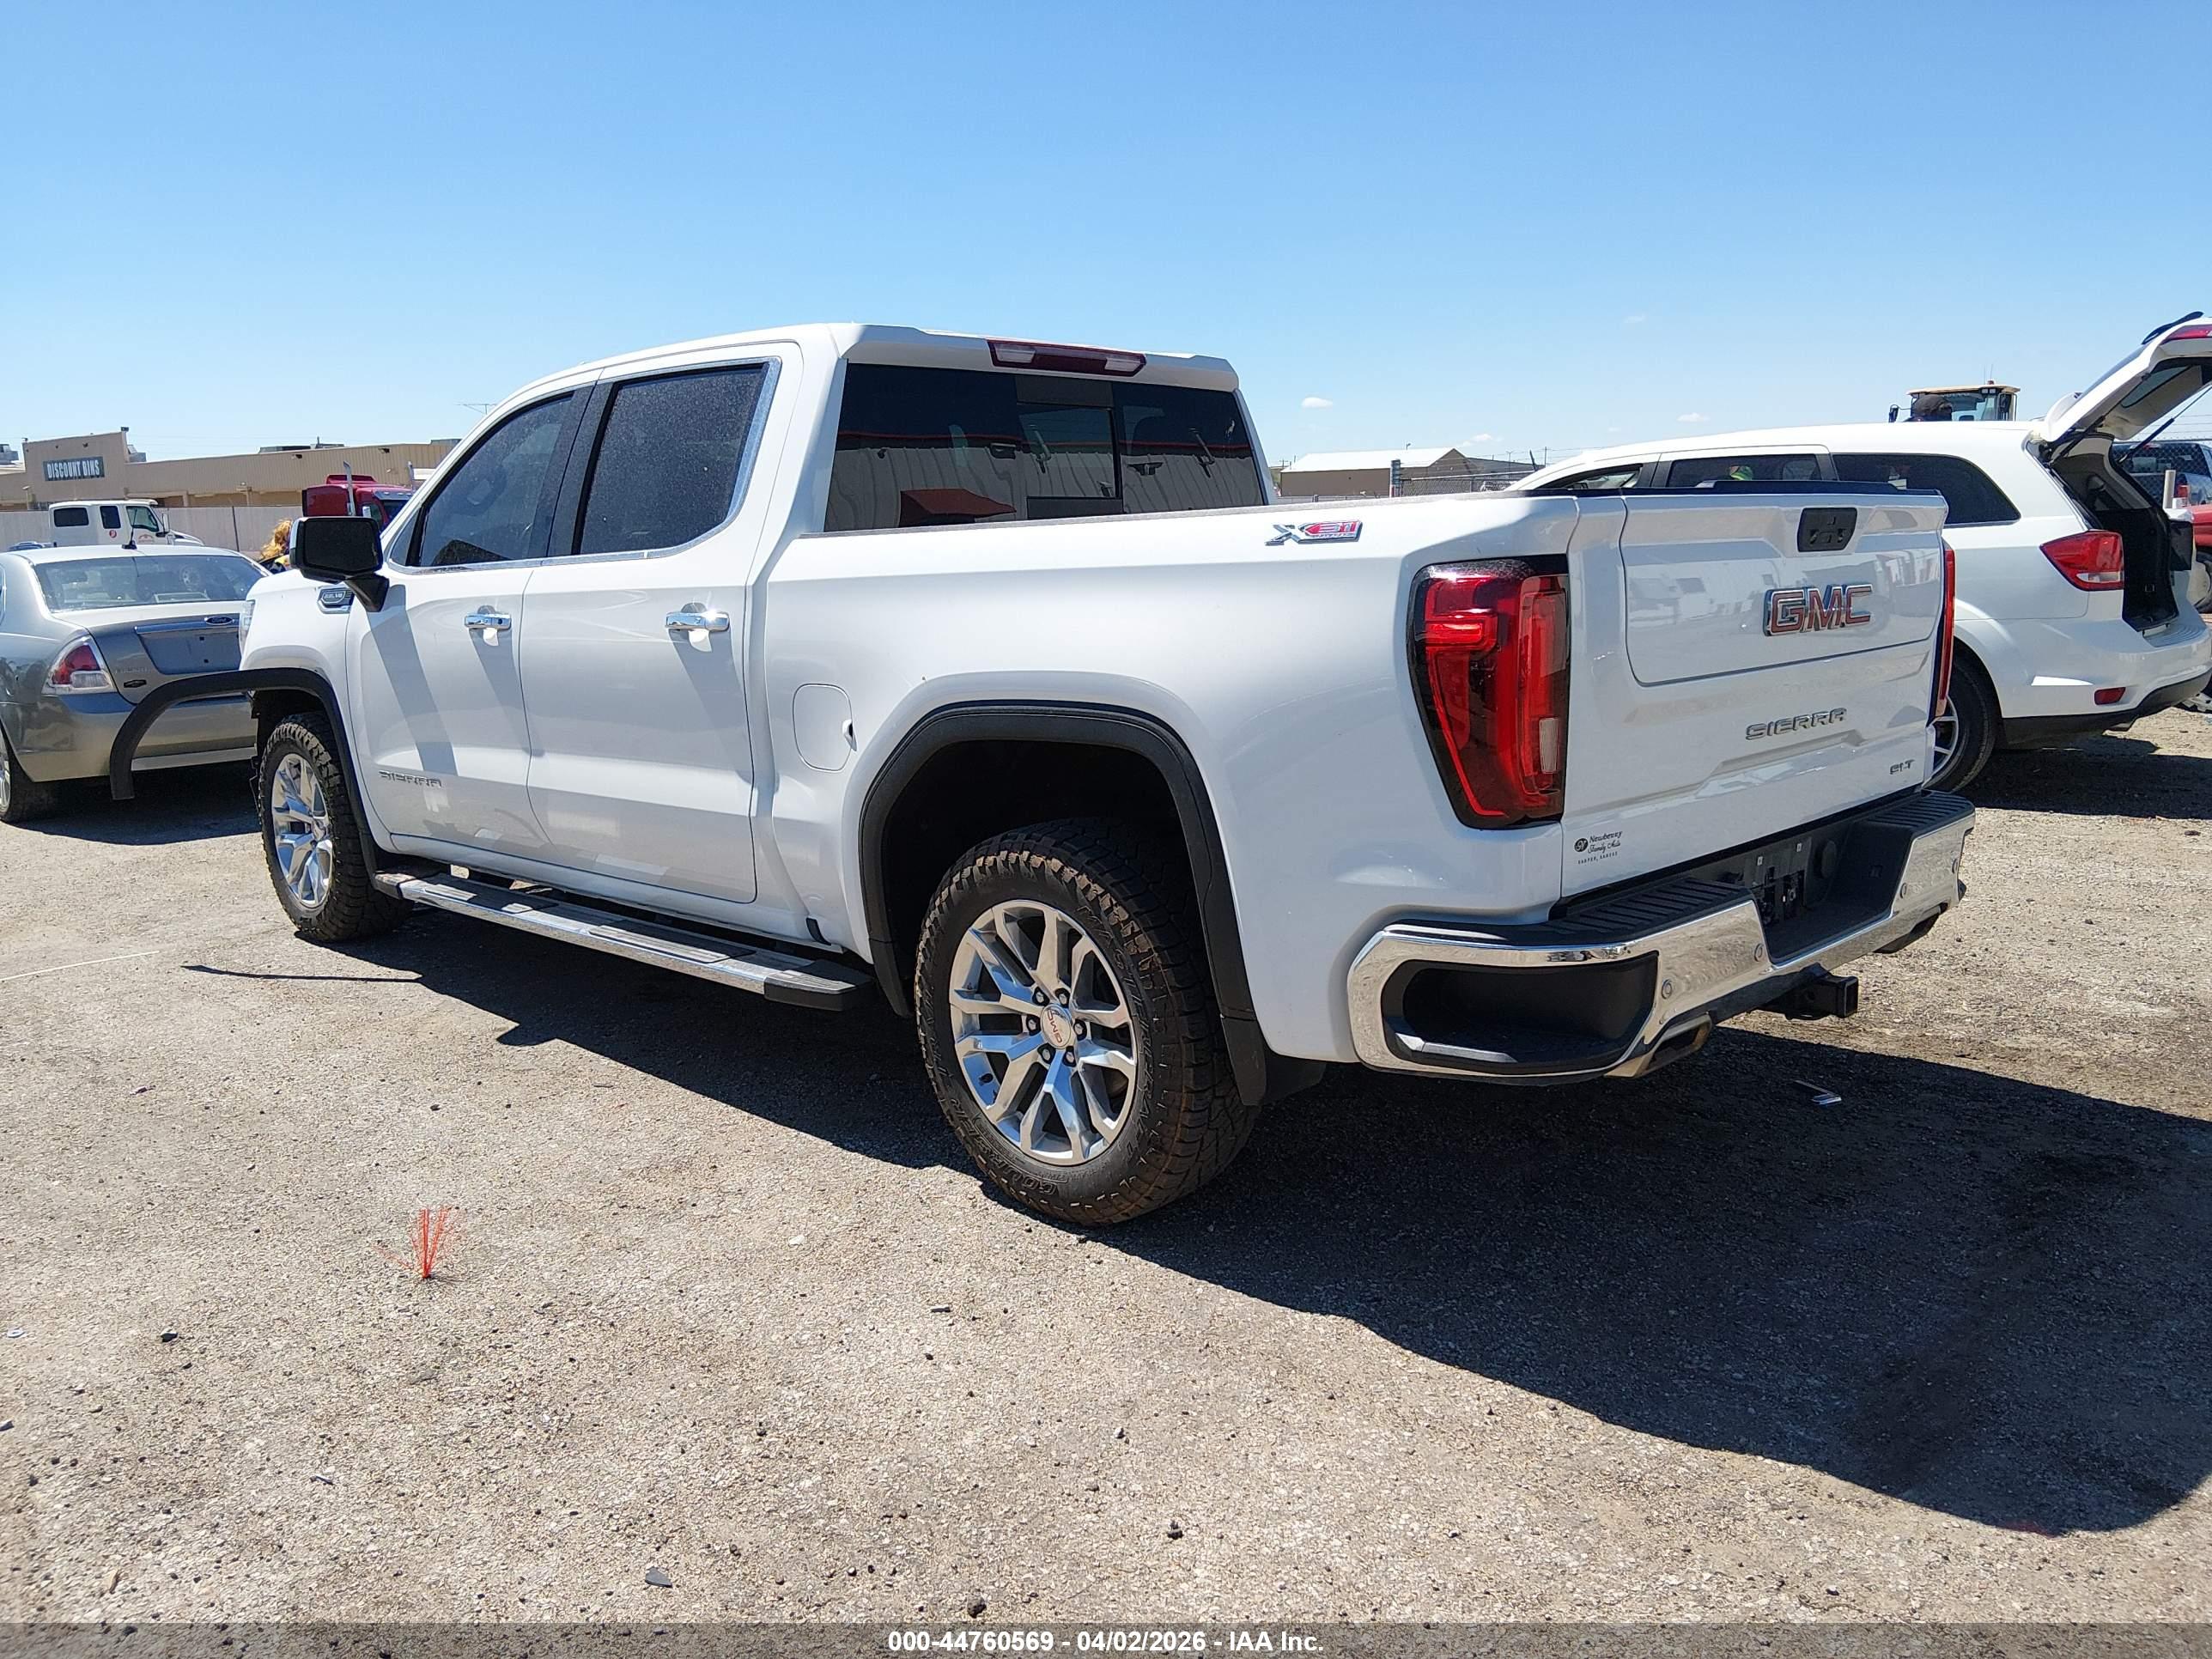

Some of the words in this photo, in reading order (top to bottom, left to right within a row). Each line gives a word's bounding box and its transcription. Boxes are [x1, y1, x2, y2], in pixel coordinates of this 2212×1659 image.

[46, 461, 82, 478] DISCOUNT
[82, 459, 100, 476] BINS
[1762, 583, 1873, 636] GMC
[1746, 707, 1848, 741] SIERRA
[1047, 1008, 1063, 1043] GMC
